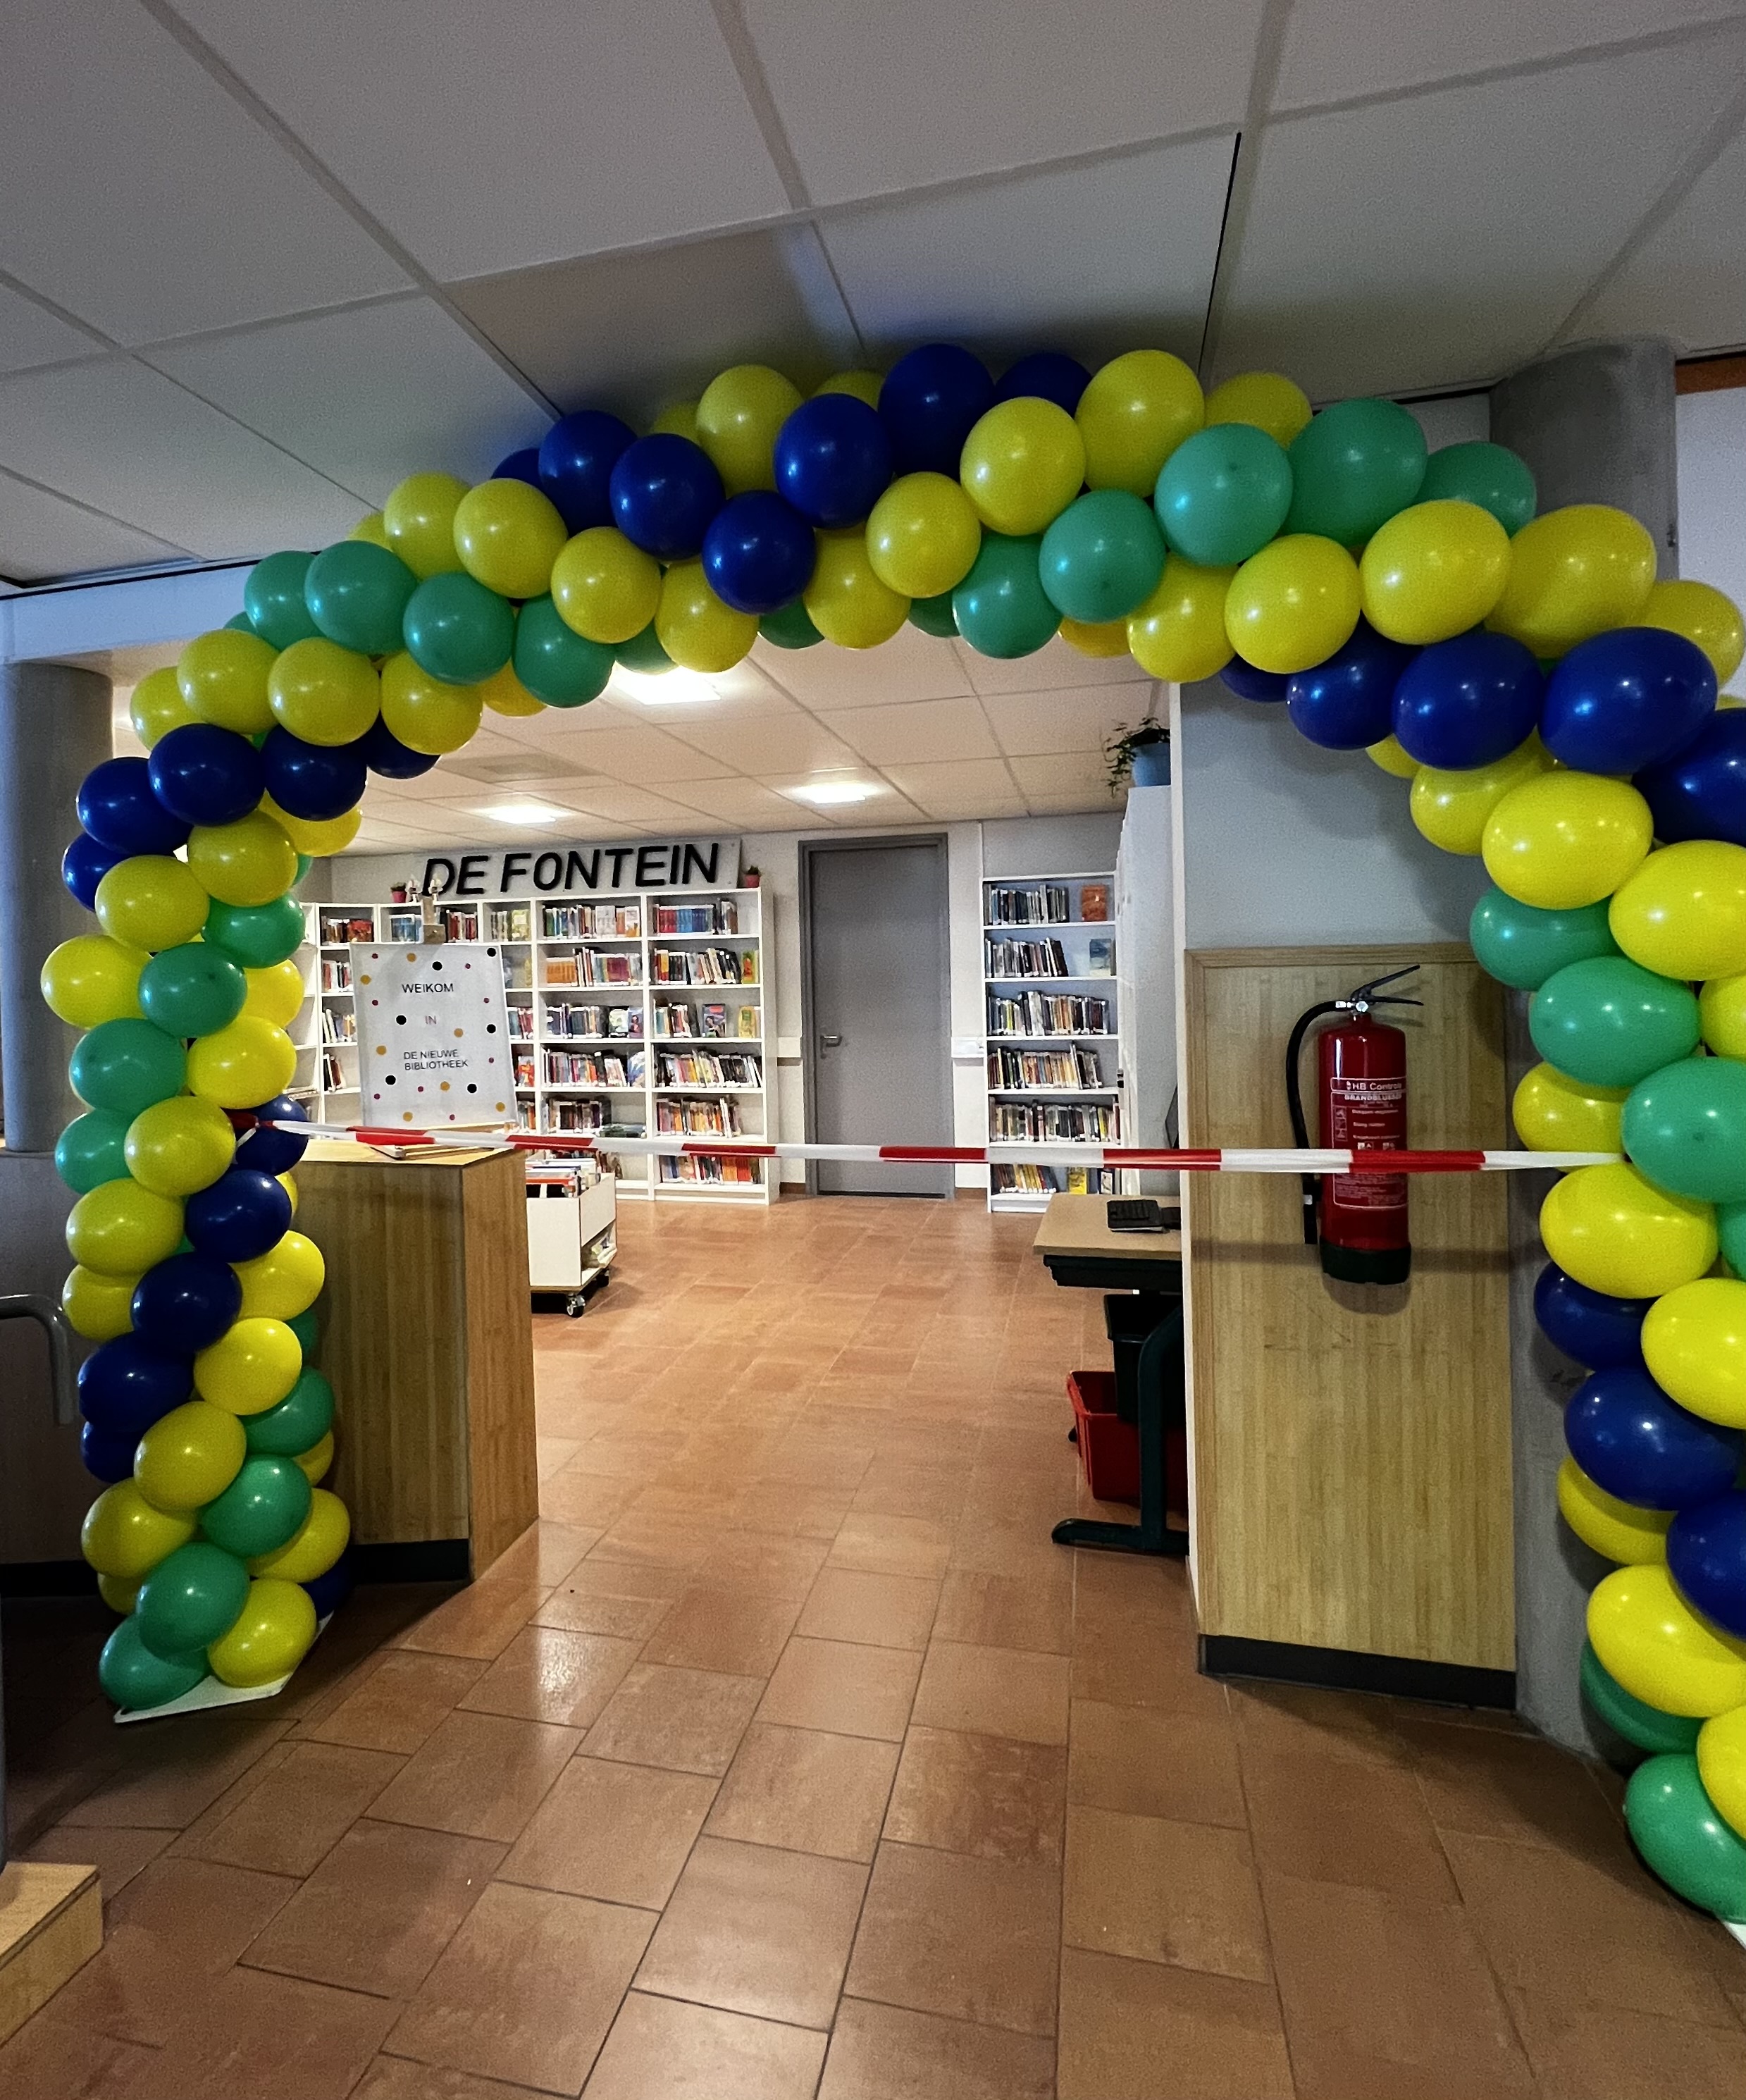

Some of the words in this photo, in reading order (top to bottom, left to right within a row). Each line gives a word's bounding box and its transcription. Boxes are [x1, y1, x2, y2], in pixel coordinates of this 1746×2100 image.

[423, 856, 488, 896] DE
[500, 843, 719, 893] FONTEIN
[425, 1015, 437, 1025] IN
[404, 1051, 418, 1060] DE
[420, 1049, 459, 1058] NIEUWE
[404, 1059, 469, 1070] BIBLIOTHEEK
